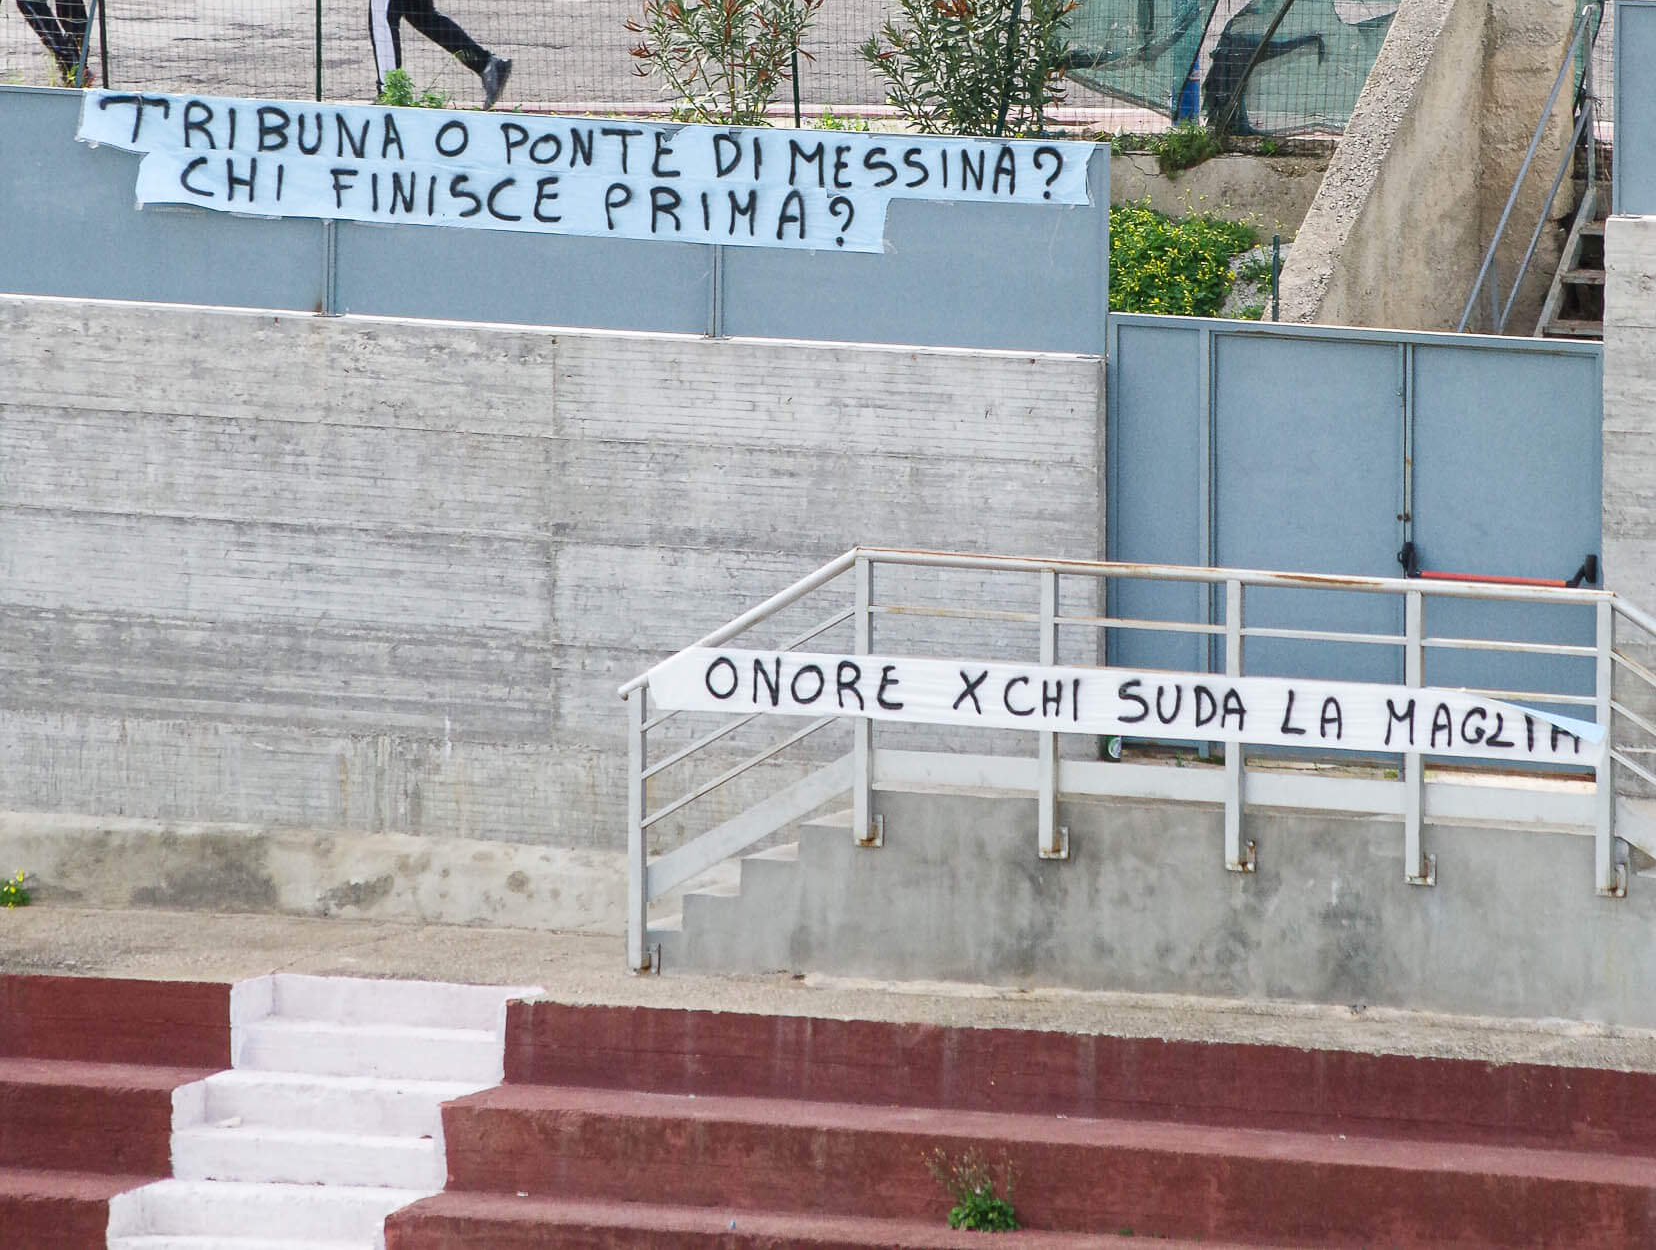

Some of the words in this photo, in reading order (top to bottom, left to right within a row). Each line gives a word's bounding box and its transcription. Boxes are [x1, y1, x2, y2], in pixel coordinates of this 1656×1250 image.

[99, 95, 404, 161] TRIBUNA
[435, 119, 469, 158] O
[500, 122, 682, 178] PONTE
[712, 130, 763, 182] DI
[788, 136, 1065, 200] MESSINA?
[179, 155, 285, 202] CHI
[329, 167, 563, 223] FINISCE
[605, 181, 856, 247] PRIMA?
[705, 656, 905, 711] ONORE
[1117, 678, 1247, 731] SUDA
[1280, 688, 1343, 740] LA
